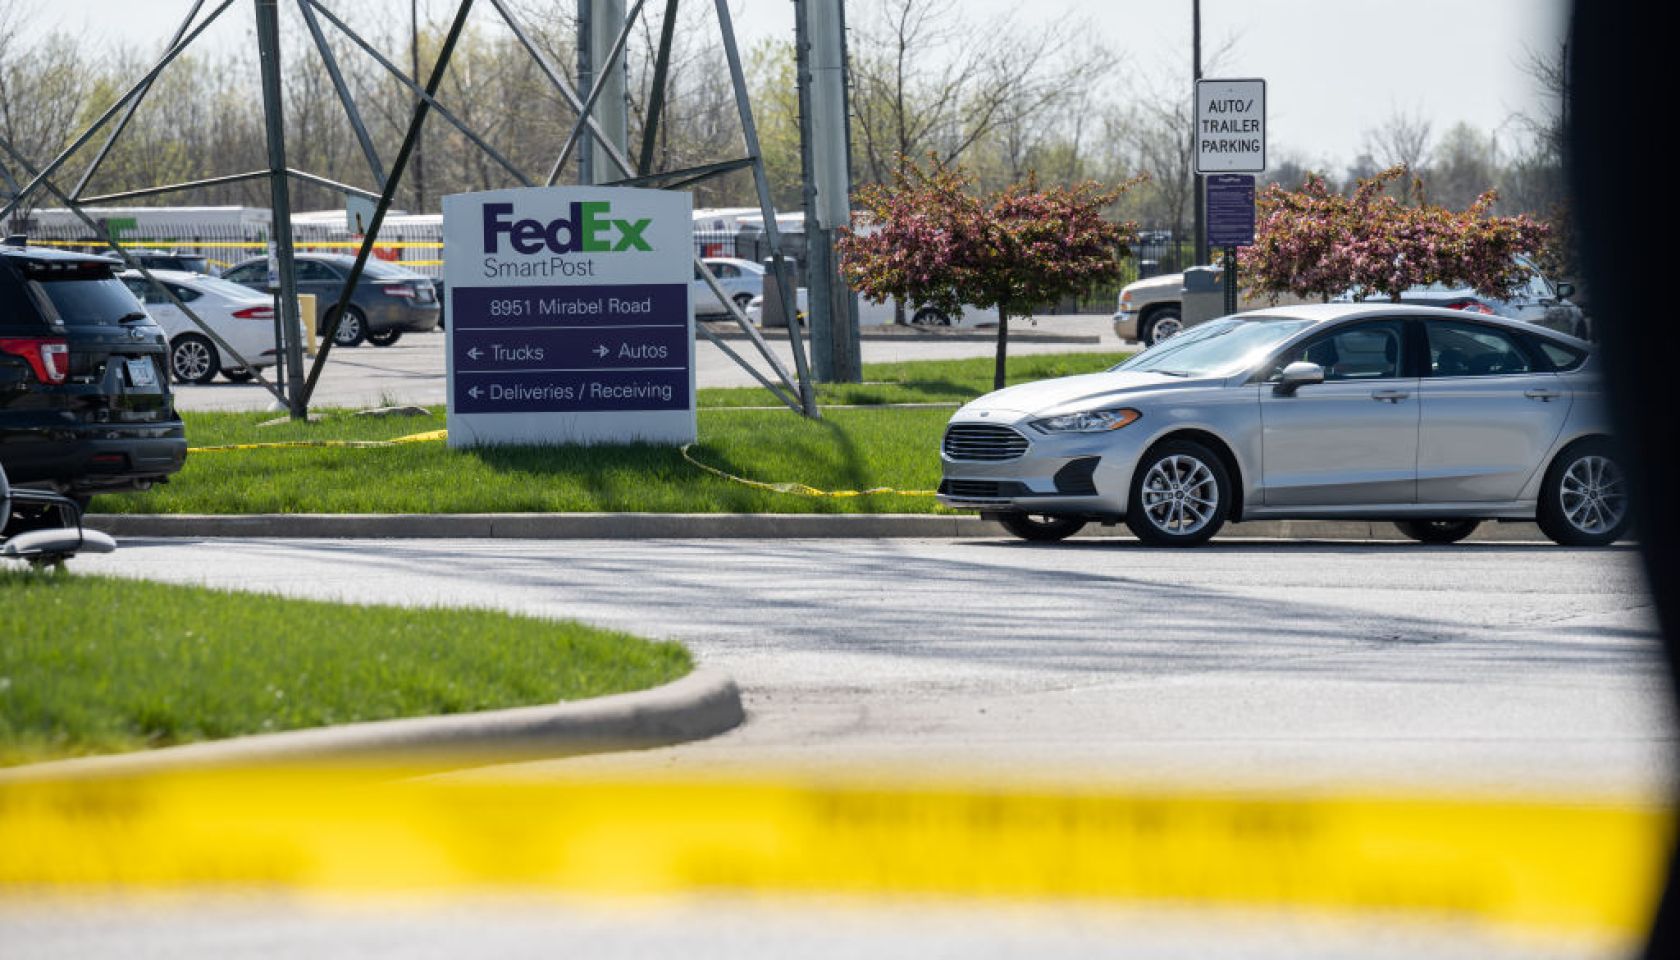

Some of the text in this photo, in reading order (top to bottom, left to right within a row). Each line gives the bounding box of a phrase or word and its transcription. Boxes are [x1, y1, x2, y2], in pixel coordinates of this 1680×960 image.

[1208, 99, 1253, 113] AUTO/
[1201, 119, 1260, 133] TRAILER
[1201, 139, 1261, 153] PARKING
[483, 201, 653, 255] FedEx
[483, 257, 595, 278] SmartPost
[489, 298, 651, 316] 8951 Mirabel Road
[491, 344, 544, 360] Trucks
[618, 342, 668, 359] Autos
[489, 383, 574, 400] Deliveries
[590, 382, 672, 401] Receiving
